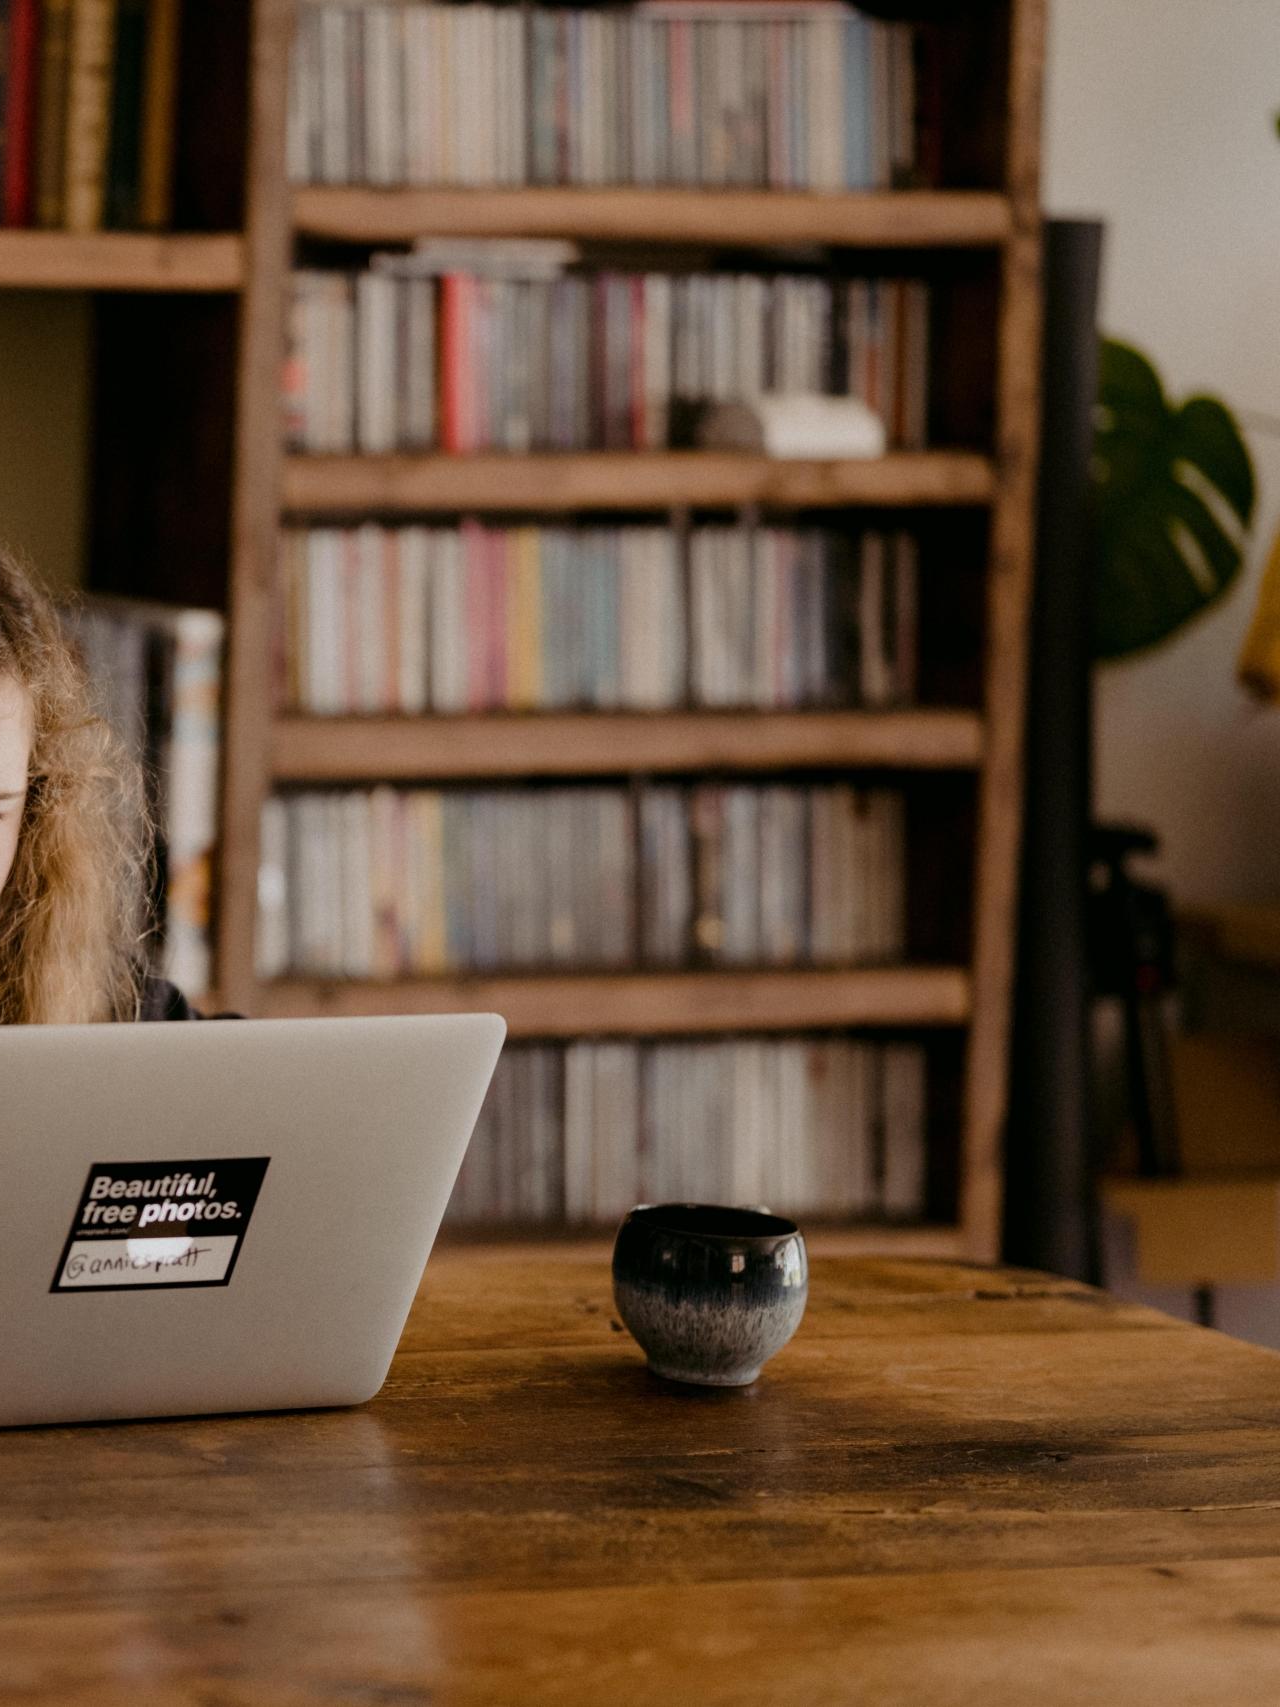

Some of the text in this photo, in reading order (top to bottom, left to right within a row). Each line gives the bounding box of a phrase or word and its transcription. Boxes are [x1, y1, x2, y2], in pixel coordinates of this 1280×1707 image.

[89, 1172, 217, 1199] Beautiful,
[82, 1198, 242, 1228] free photos.
